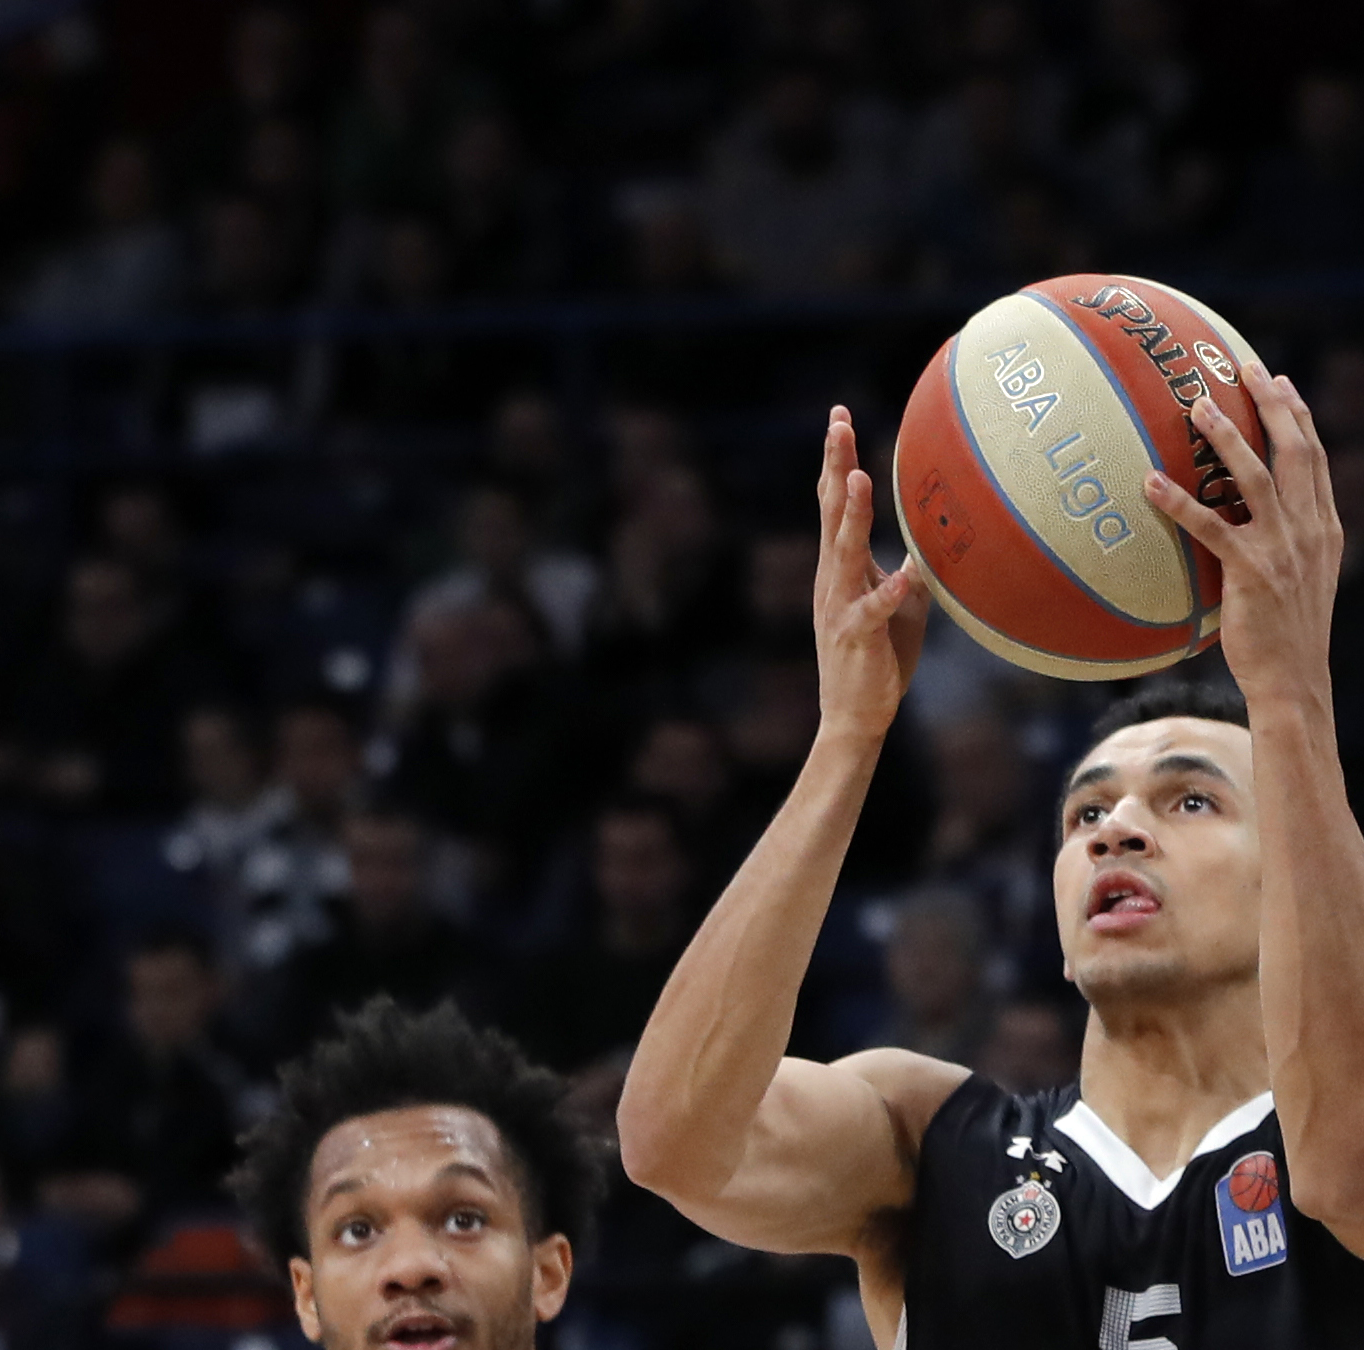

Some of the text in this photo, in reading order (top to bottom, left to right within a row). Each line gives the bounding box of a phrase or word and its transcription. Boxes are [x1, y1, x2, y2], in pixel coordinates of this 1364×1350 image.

[985, 341, 1135, 554] ABA Liga
[1233, 1212, 1286, 1265] ABA
